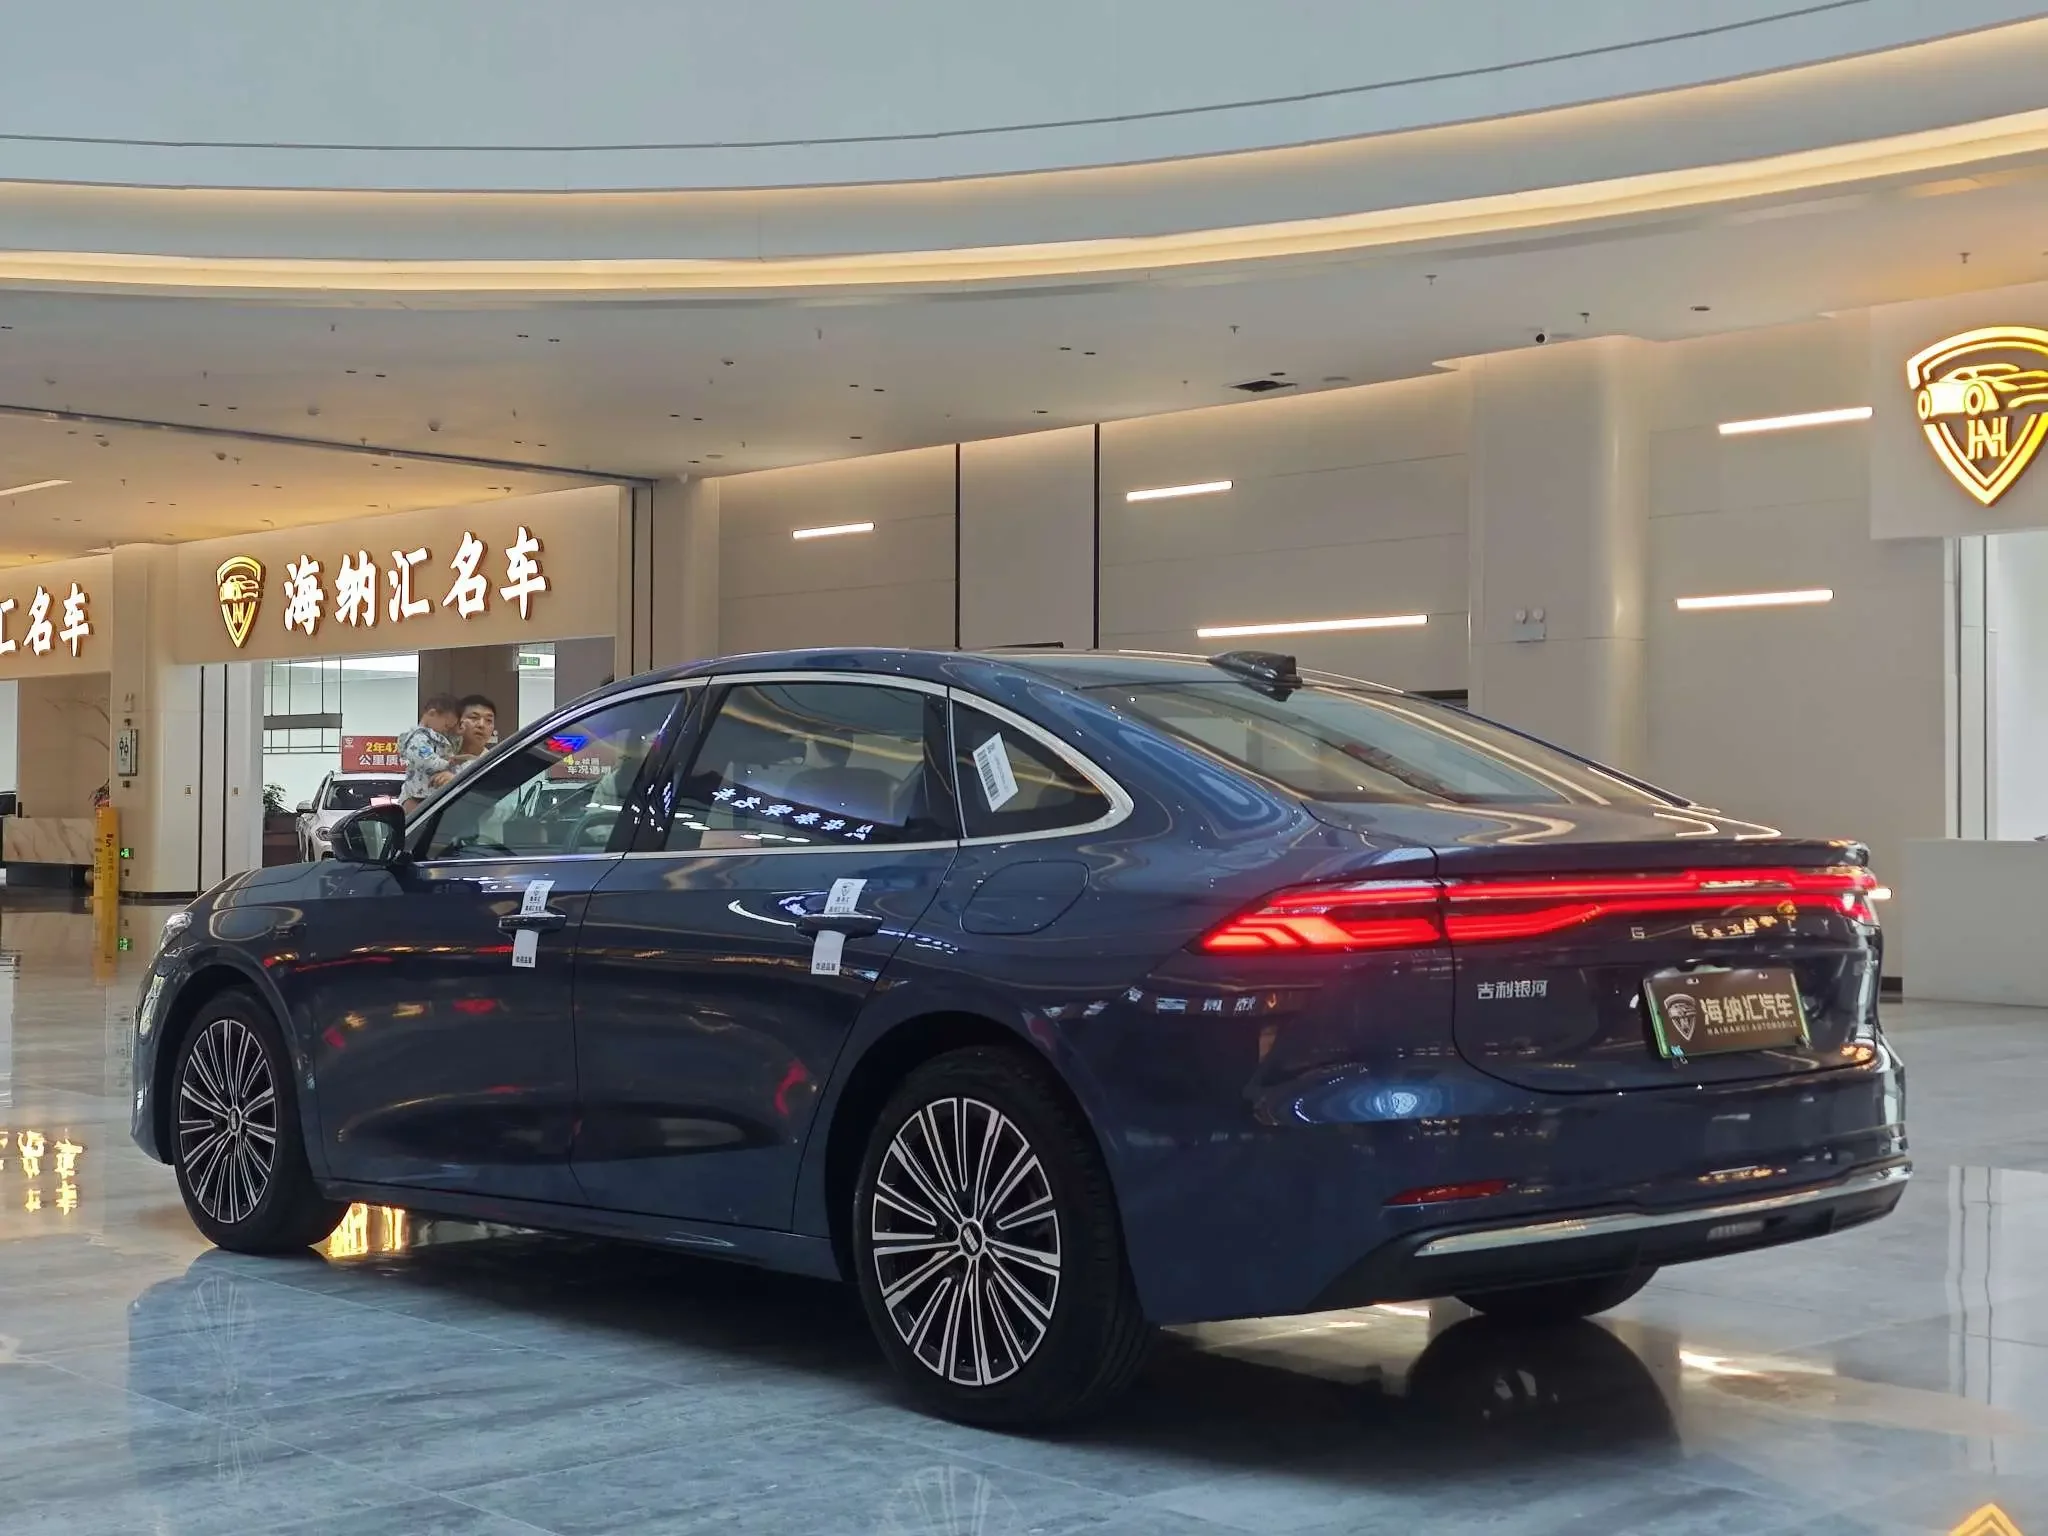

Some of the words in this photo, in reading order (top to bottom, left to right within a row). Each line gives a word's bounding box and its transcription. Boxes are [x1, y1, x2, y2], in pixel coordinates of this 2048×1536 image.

[284, 526, 547, 634] 海纳汇名车
[1631, 918, 1829, 939] GELY
[1476, 980, 1548, 1000] 吉利银河
[1699, 993, 1795, 1025] 海纳汇汽车
